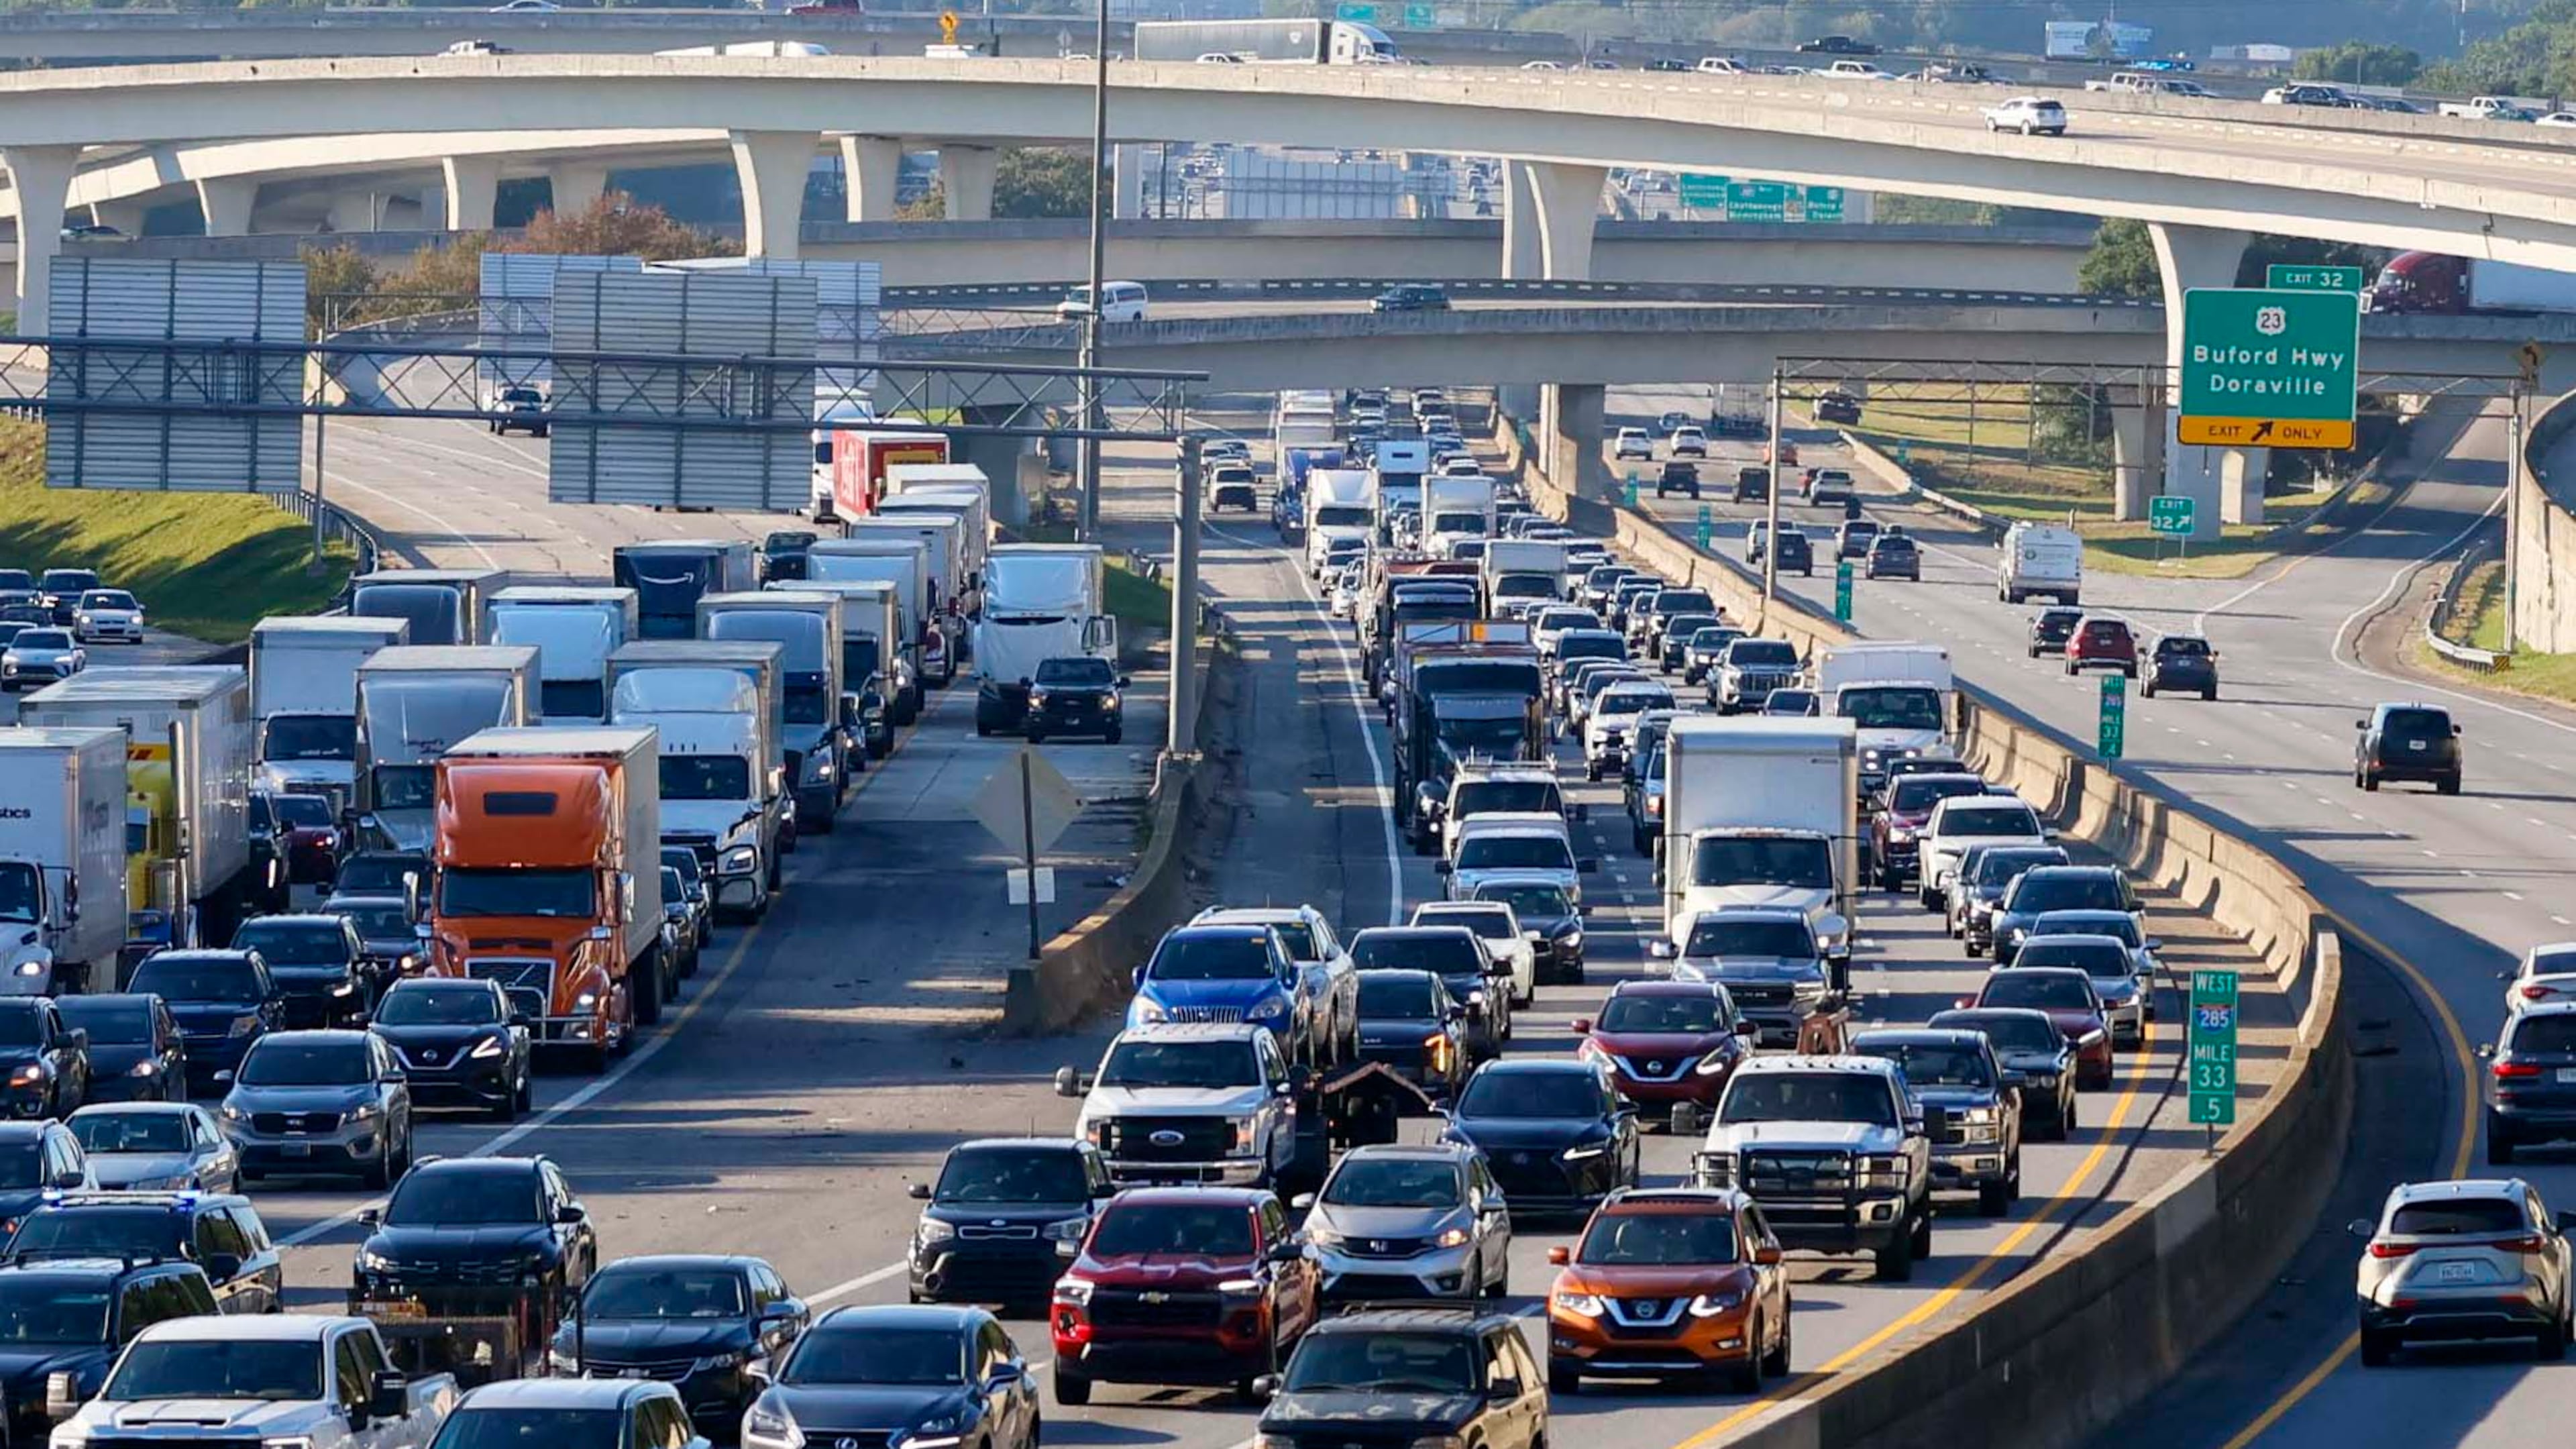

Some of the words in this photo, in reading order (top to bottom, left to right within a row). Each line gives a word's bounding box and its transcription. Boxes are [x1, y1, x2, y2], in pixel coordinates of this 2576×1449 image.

[2286, 274, 2312, 284] EXIT
[2320, 272, 2343, 287] 32
[2260, 313, 2282, 329] 23
[2194, 345, 2278, 364] Buford
[2292, 349, 2345, 370] Hwy
[2210, 375, 2326, 395] Doraville
[2208, 426, 2241, 437] EXIT
[2283, 428, 2322, 439] ONLY
[2159, 500, 2184, 509] EXIT
[2153, 516, 2174, 529] 32
[2195, 973, 2234, 993] WEST
[2200, 1008, 2229, 1028] 285
[2194, 1044, 2231, 1063] MILE
[2198, 1065, 2226, 1087] 33
